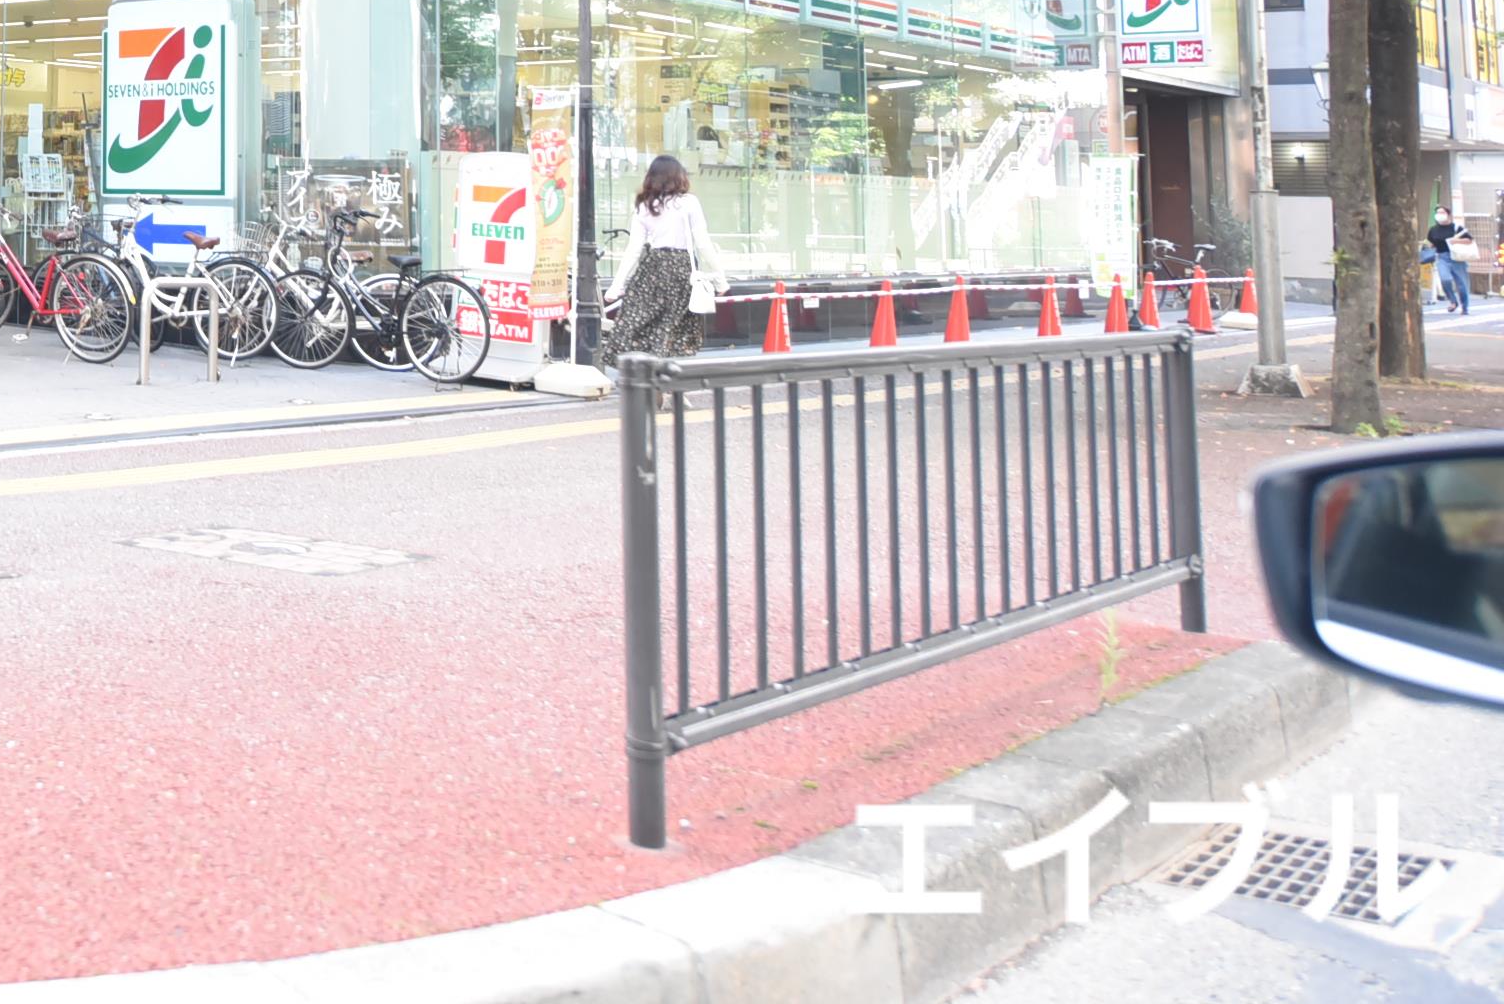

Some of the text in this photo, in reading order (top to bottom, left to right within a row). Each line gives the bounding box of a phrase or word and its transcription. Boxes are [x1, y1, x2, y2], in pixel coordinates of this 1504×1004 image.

[1123, 45, 1147, 61] ATM
[1153, 44, 1171, 61] 酒
[1177, 43, 1203, 60] たばこ
[156, 81, 215, 97] HOLDINGS
[366, 170, 405, 235] 極み
